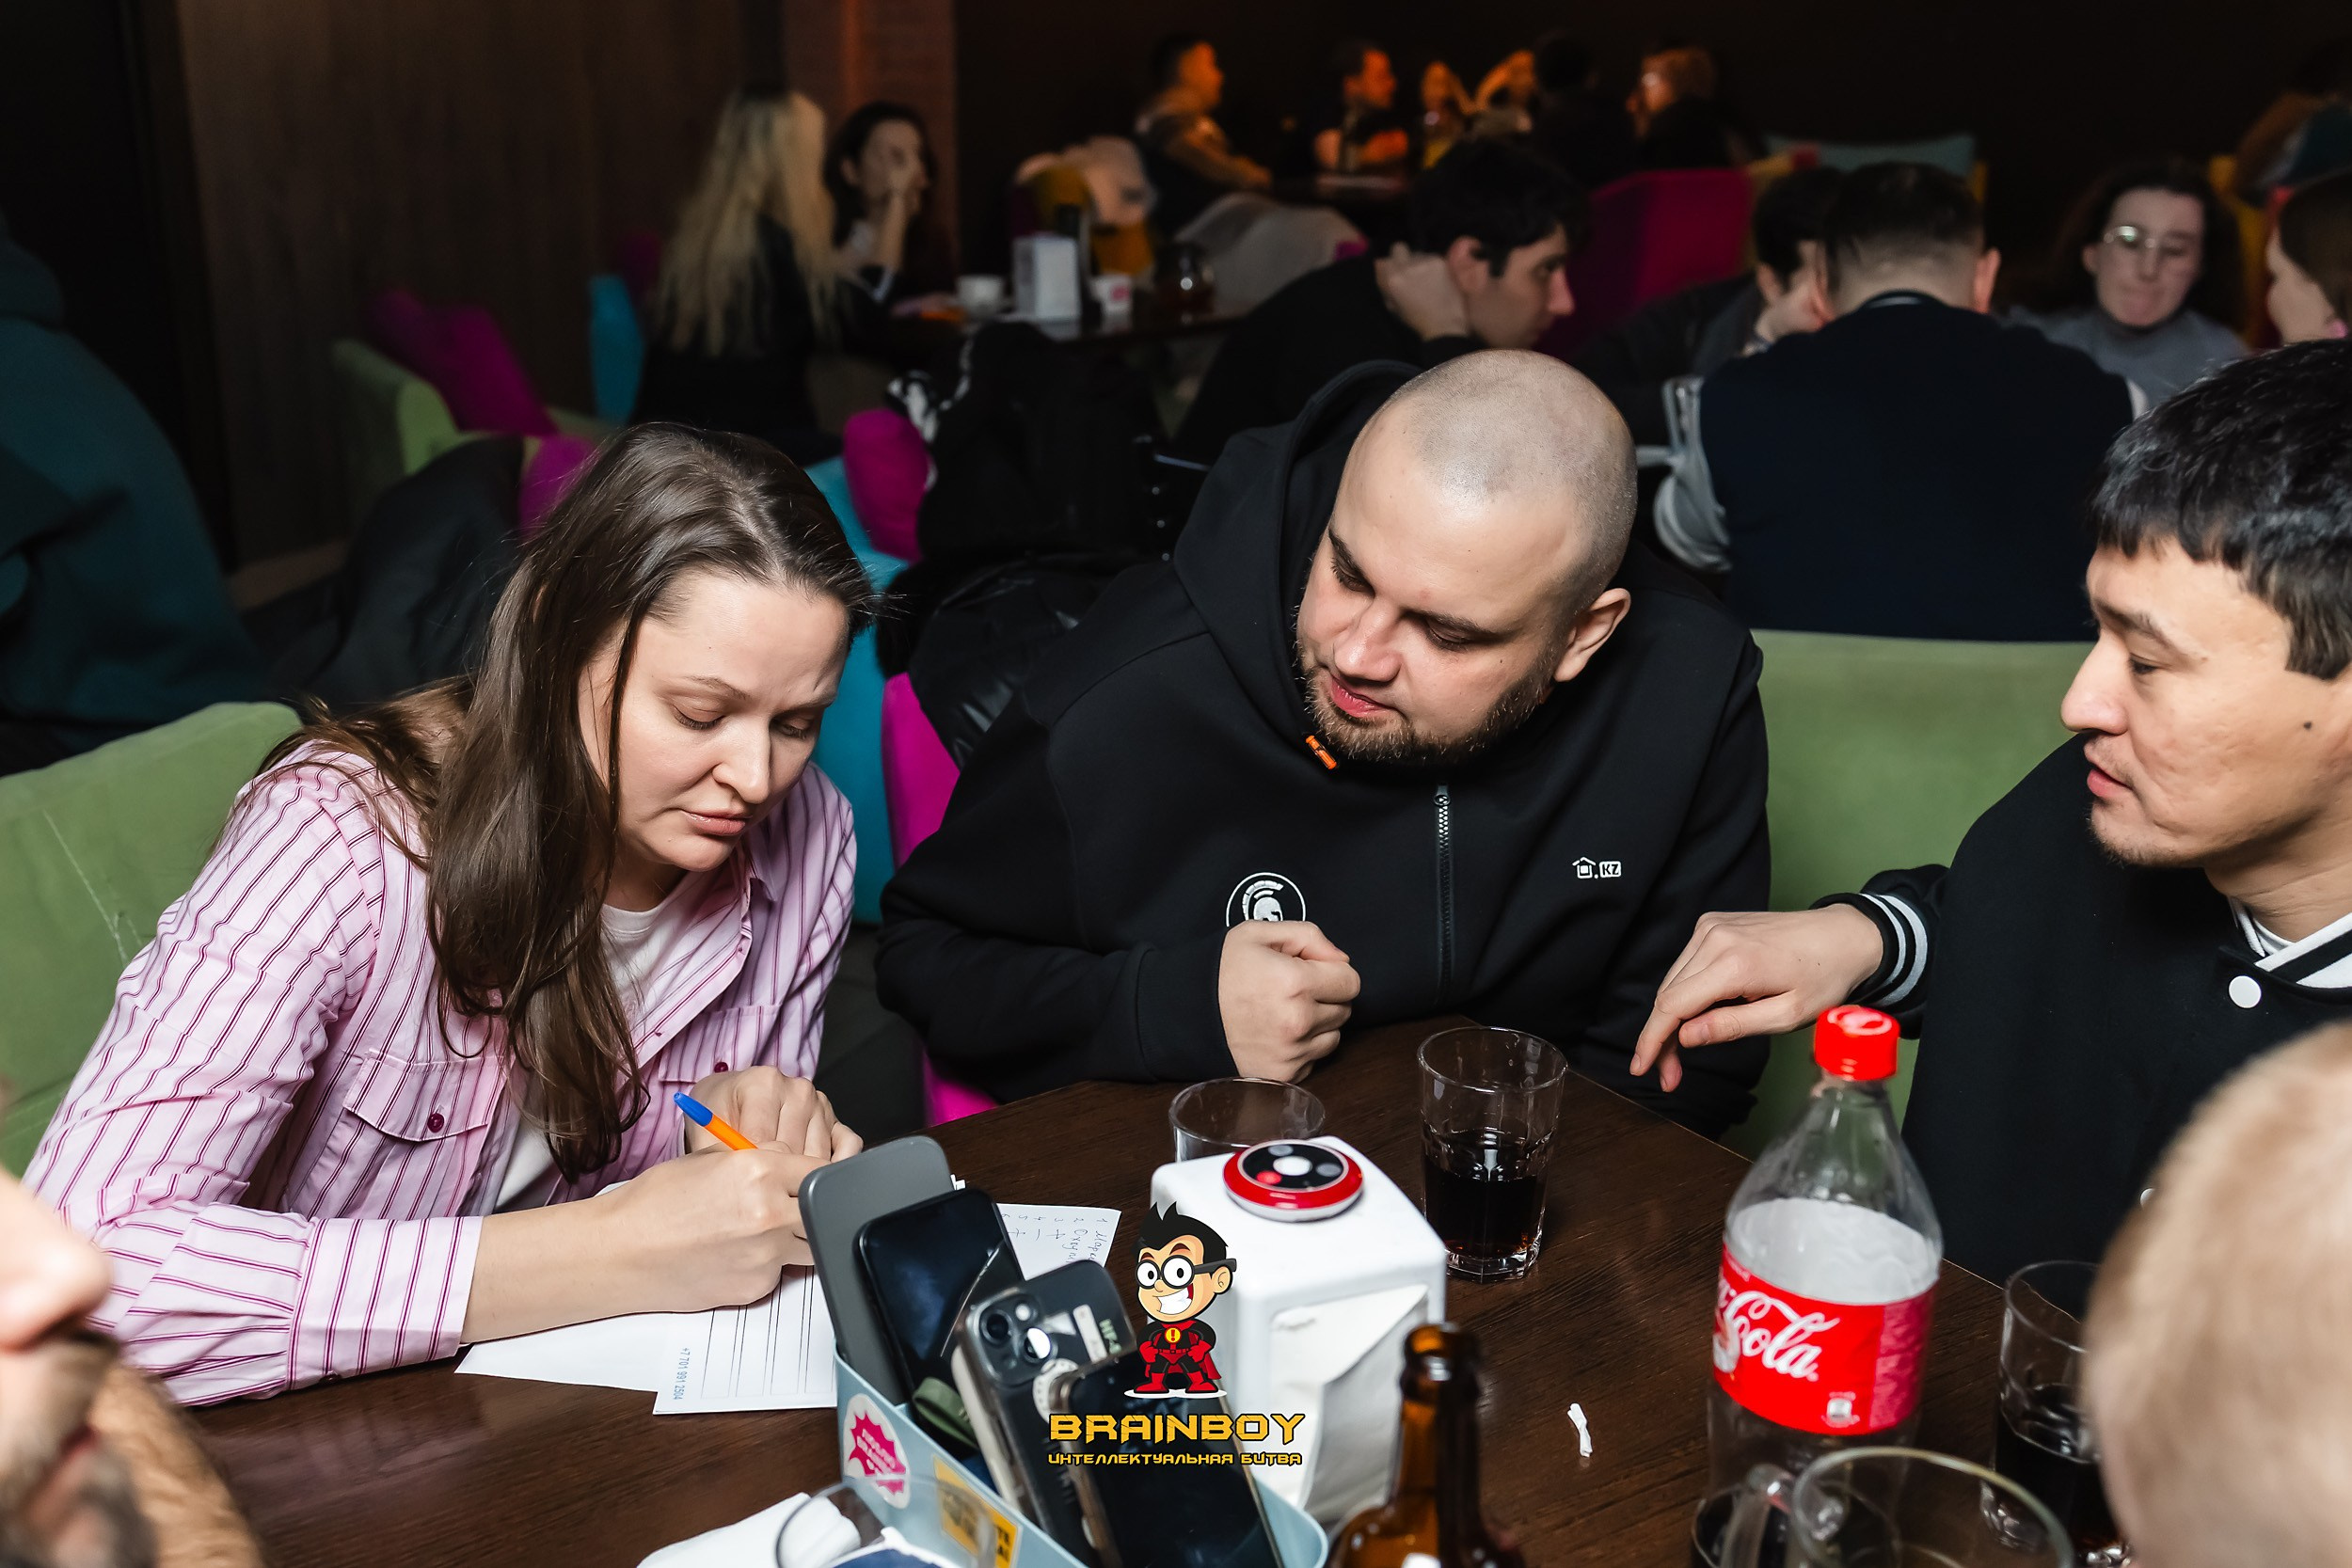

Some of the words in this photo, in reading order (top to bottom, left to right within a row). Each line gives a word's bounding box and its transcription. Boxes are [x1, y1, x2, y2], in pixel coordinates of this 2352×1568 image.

[677, 1357, 690, 1370] 701
[675, 1370, 688, 1383] 991
[673, 1385, 686, 1400] 2504
